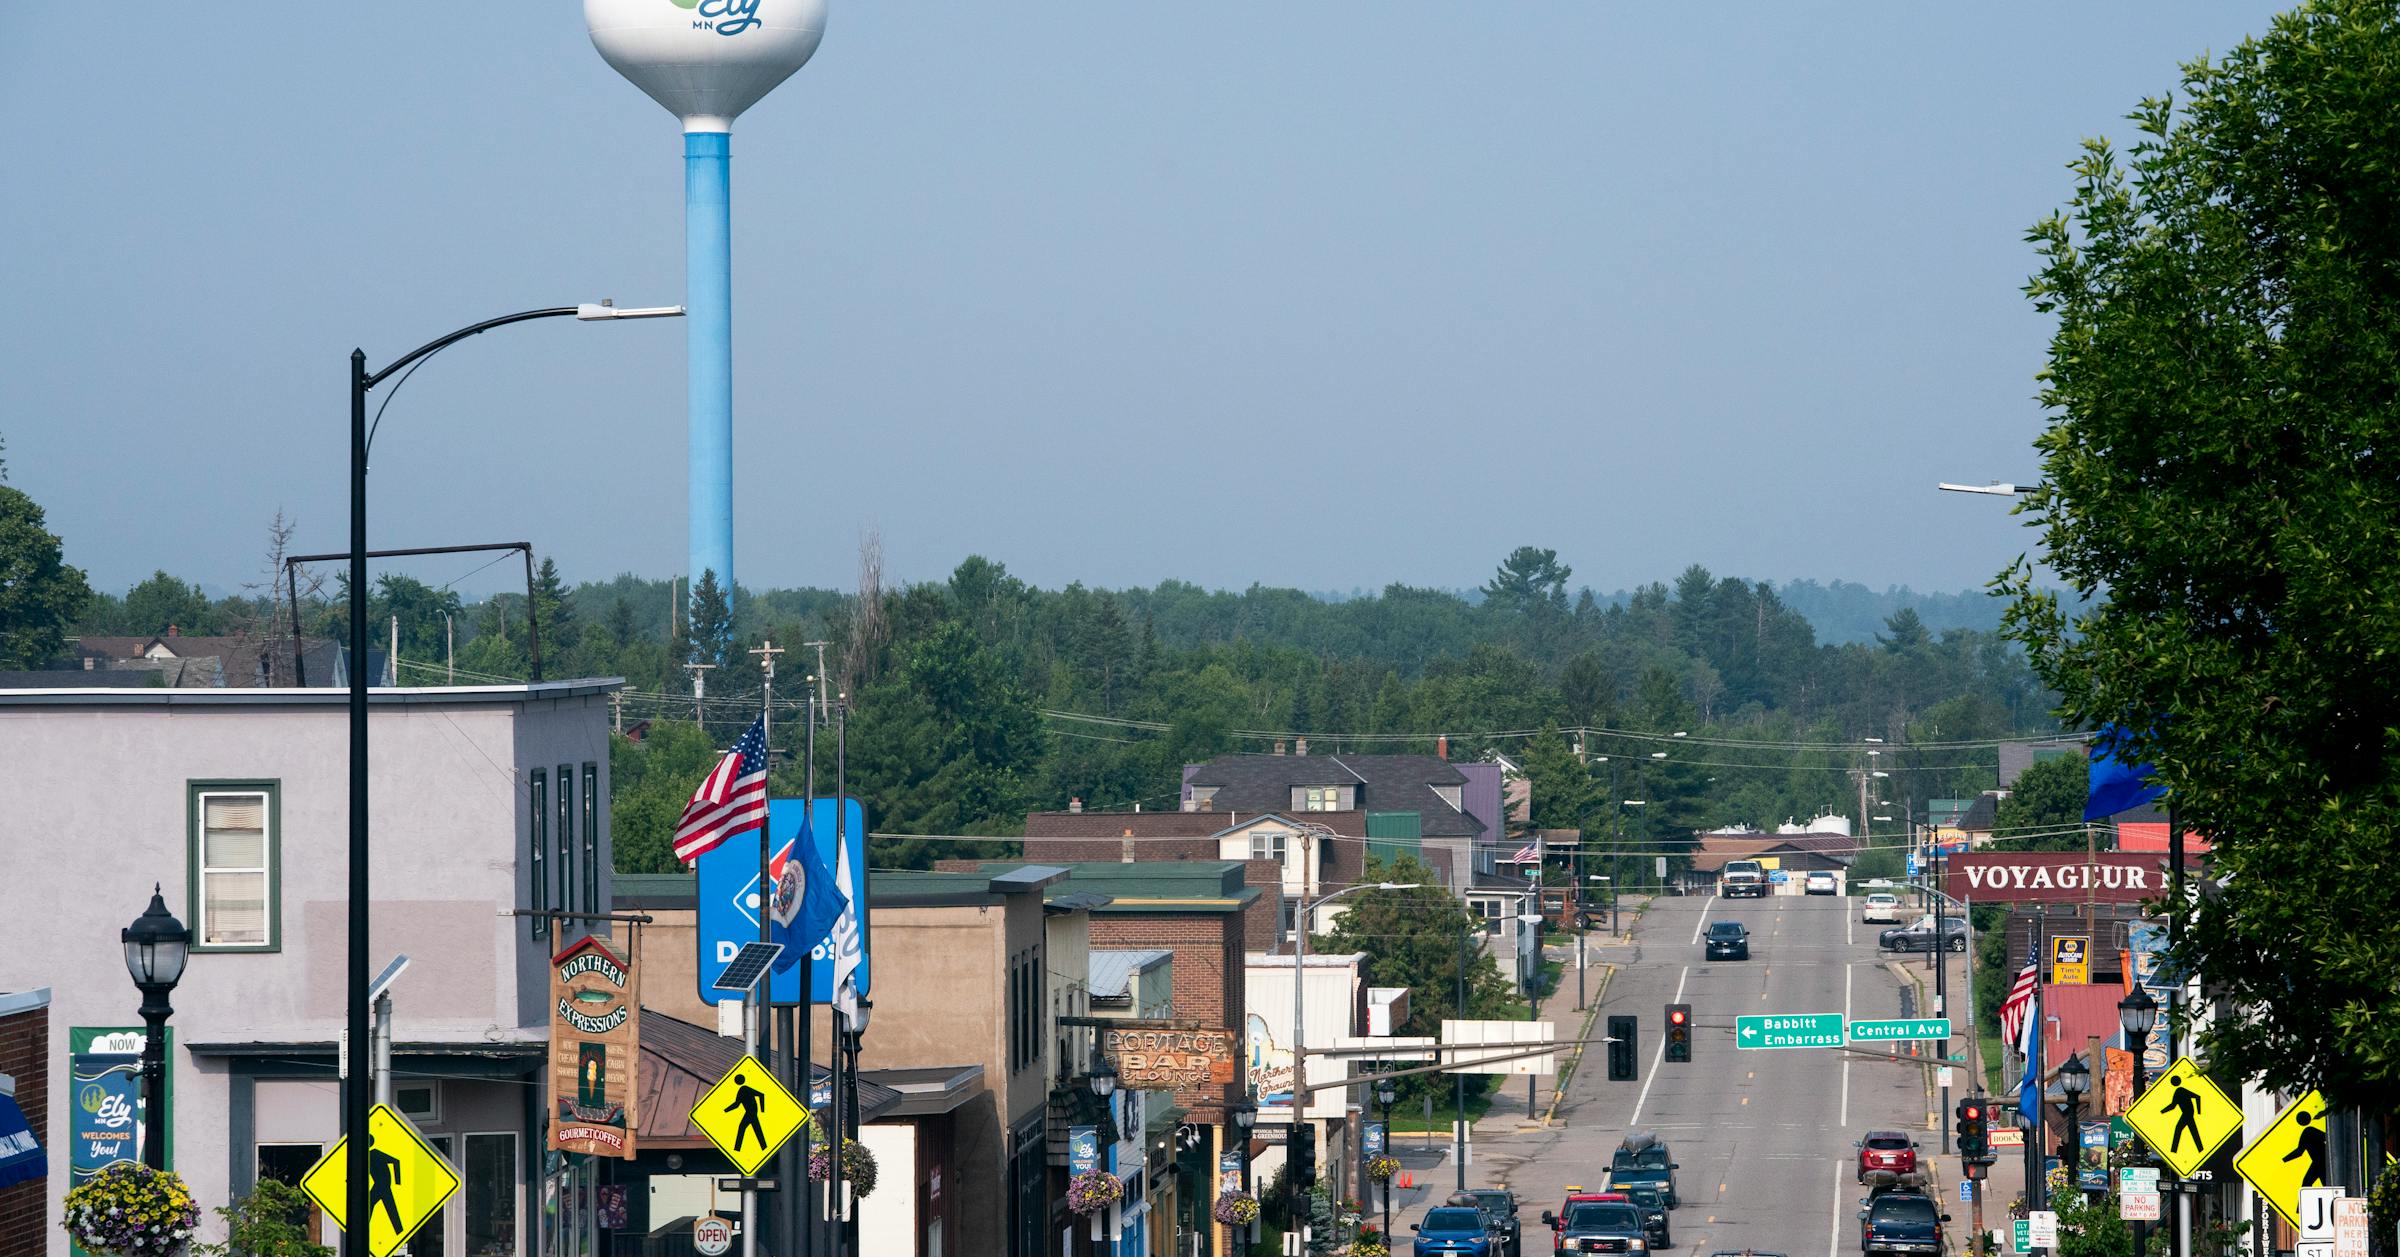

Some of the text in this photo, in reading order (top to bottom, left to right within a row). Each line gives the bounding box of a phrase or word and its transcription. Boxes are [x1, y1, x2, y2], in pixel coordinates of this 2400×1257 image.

[692, 21, 713, 30] MN
[1964, 865, 2147, 889] VOYAGEUR
[561, 955, 626, 988] NORTHERN
[558, 998, 627, 1033] EXPRESSIONS
[1764, 1018, 1817, 1030] Babbitt
[1856, 1024, 1944, 1036] Central Ave
[109, 1039, 136, 1051] NOW
[1105, 1031, 1228, 1055] PORTAGE
[1764, 1034, 1841, 1046] Embarrass
[1122, 1054, 1212, 1070] BAR
[1136, 1071, 1212, 1082] LOUNGE
[97, 1094, 132, 1128] Ely
[81, 1131, 131, 1141] WELCOMES
[559, 1127, 593, 1141] GOURMET
[594, 1129, 622, 1150] COFFEE
[2114, 1130, 2130, 1139] The
[89, 1141, 121, 1159] You!
[2190, 1171, 2213, 1181] IFTS
[2134, 1196, 2147, 1204] NO
[2261, 1198, 2271, 1257] SPORTSWE
[697, 1228, 728, 1243] OPEN
[2351, 1240, 2362, 1249] TO
